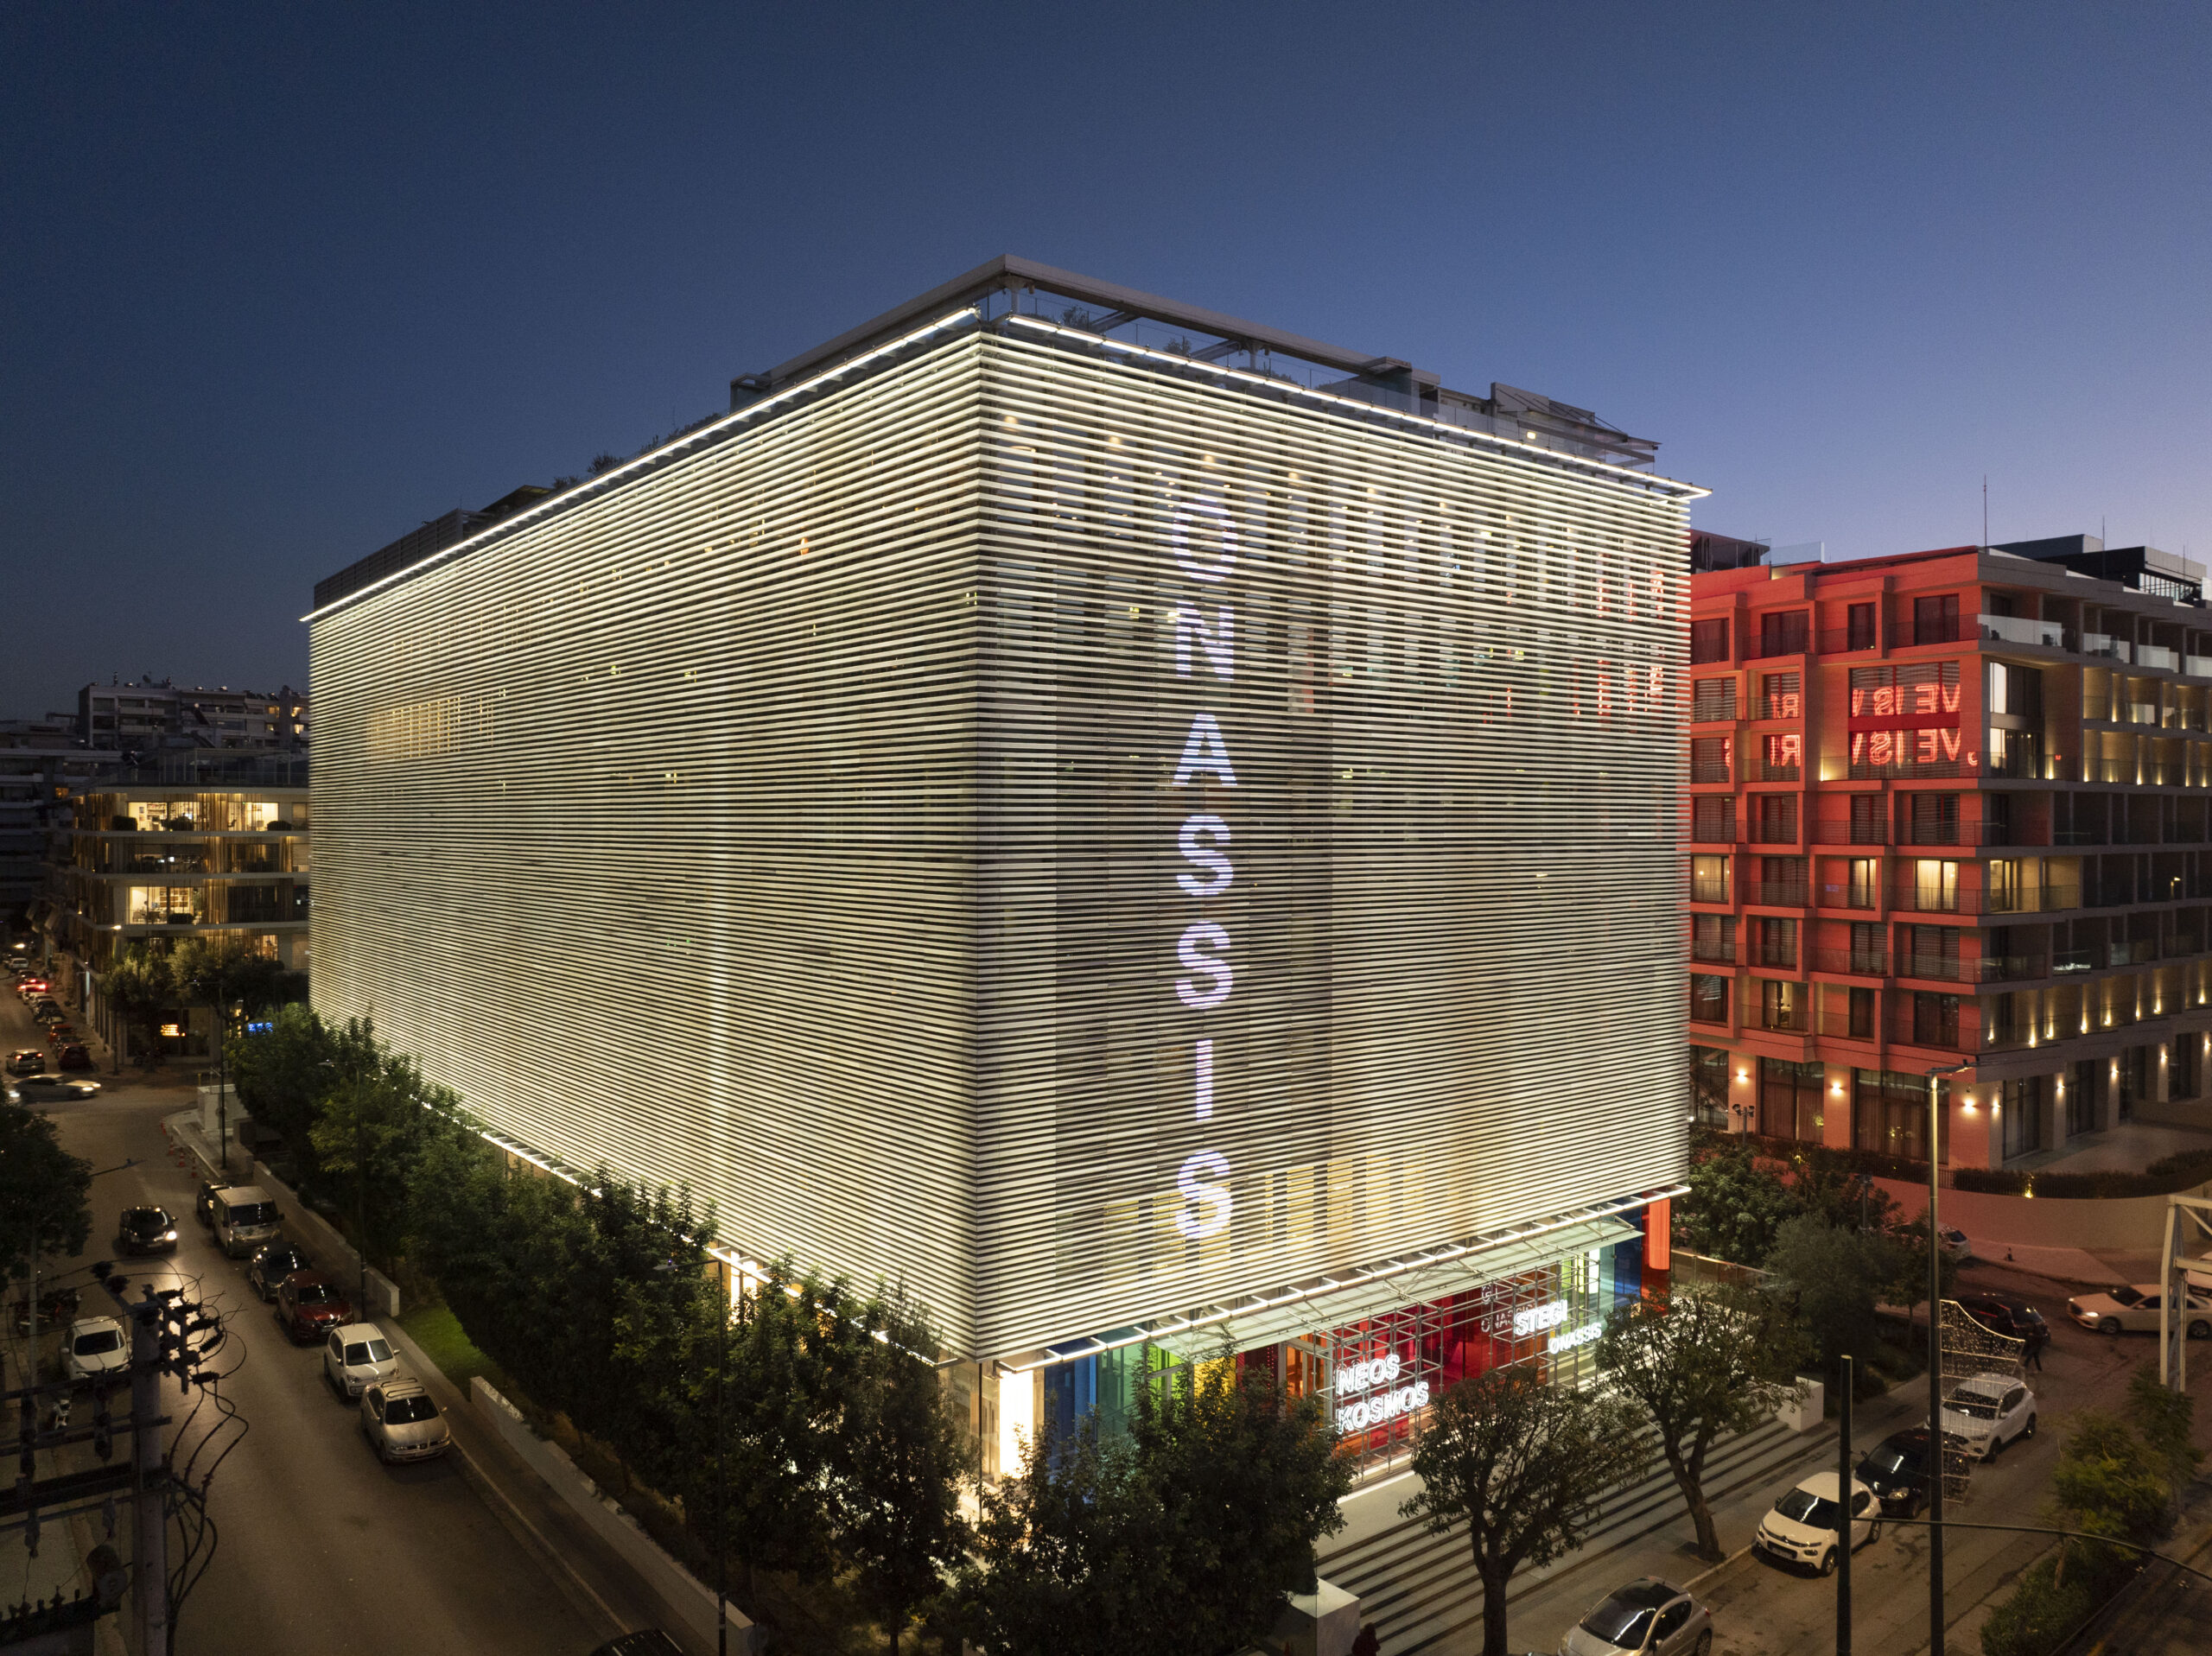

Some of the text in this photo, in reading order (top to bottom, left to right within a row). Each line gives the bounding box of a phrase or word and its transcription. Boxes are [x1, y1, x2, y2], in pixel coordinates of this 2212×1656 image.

[1172, 498, 1239, 1240] ONASSIS
[1515, 1299, 1568, 1336] STEGI
[1548, 1322, 1602, 1355] ONASSIS
[1336, 1354, 1401, 1395] NEOS
[1336, 1381, 1429, 1435] KOSMOS
